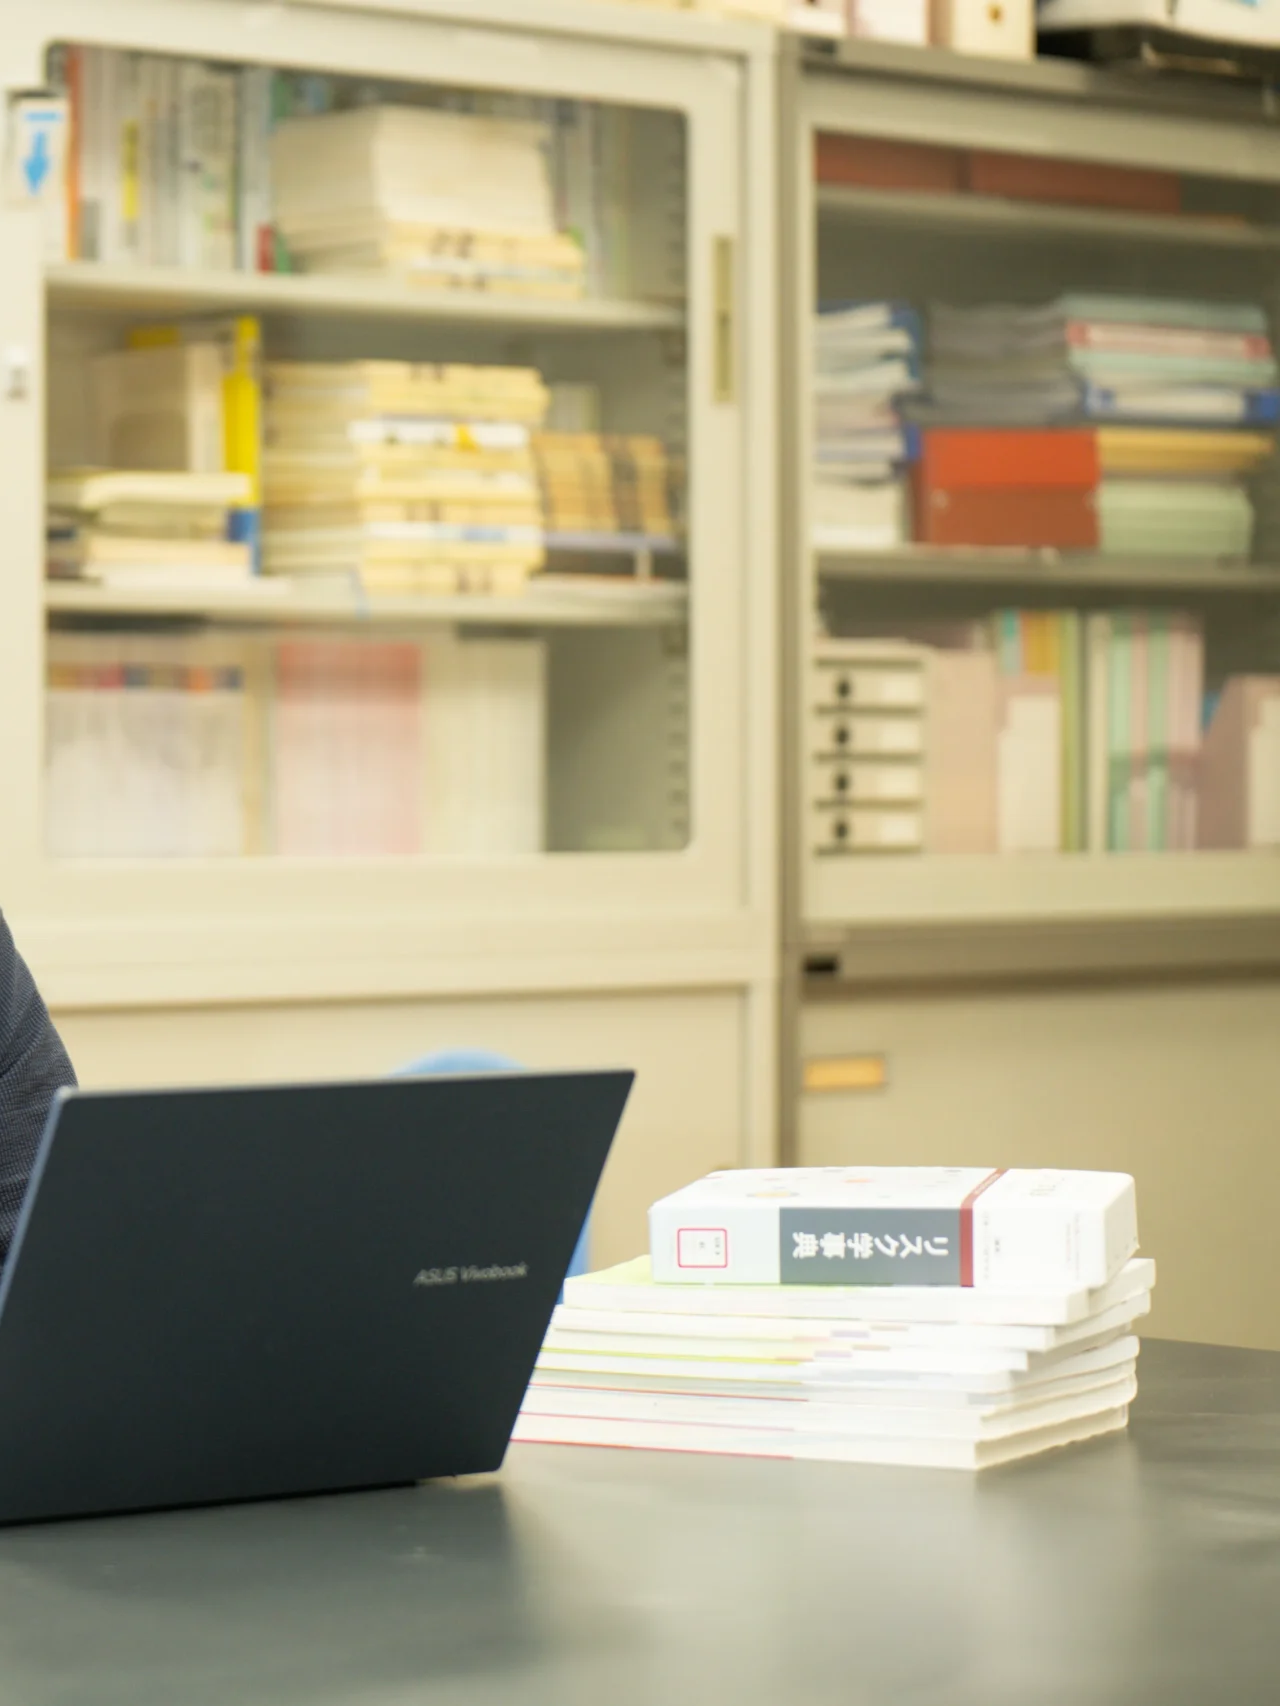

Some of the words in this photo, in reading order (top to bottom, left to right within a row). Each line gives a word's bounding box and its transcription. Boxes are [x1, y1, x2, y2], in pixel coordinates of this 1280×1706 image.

[792, 1232, 949, 1259] リスク学事典
[413, 1266, 459, 1287] ASUS
